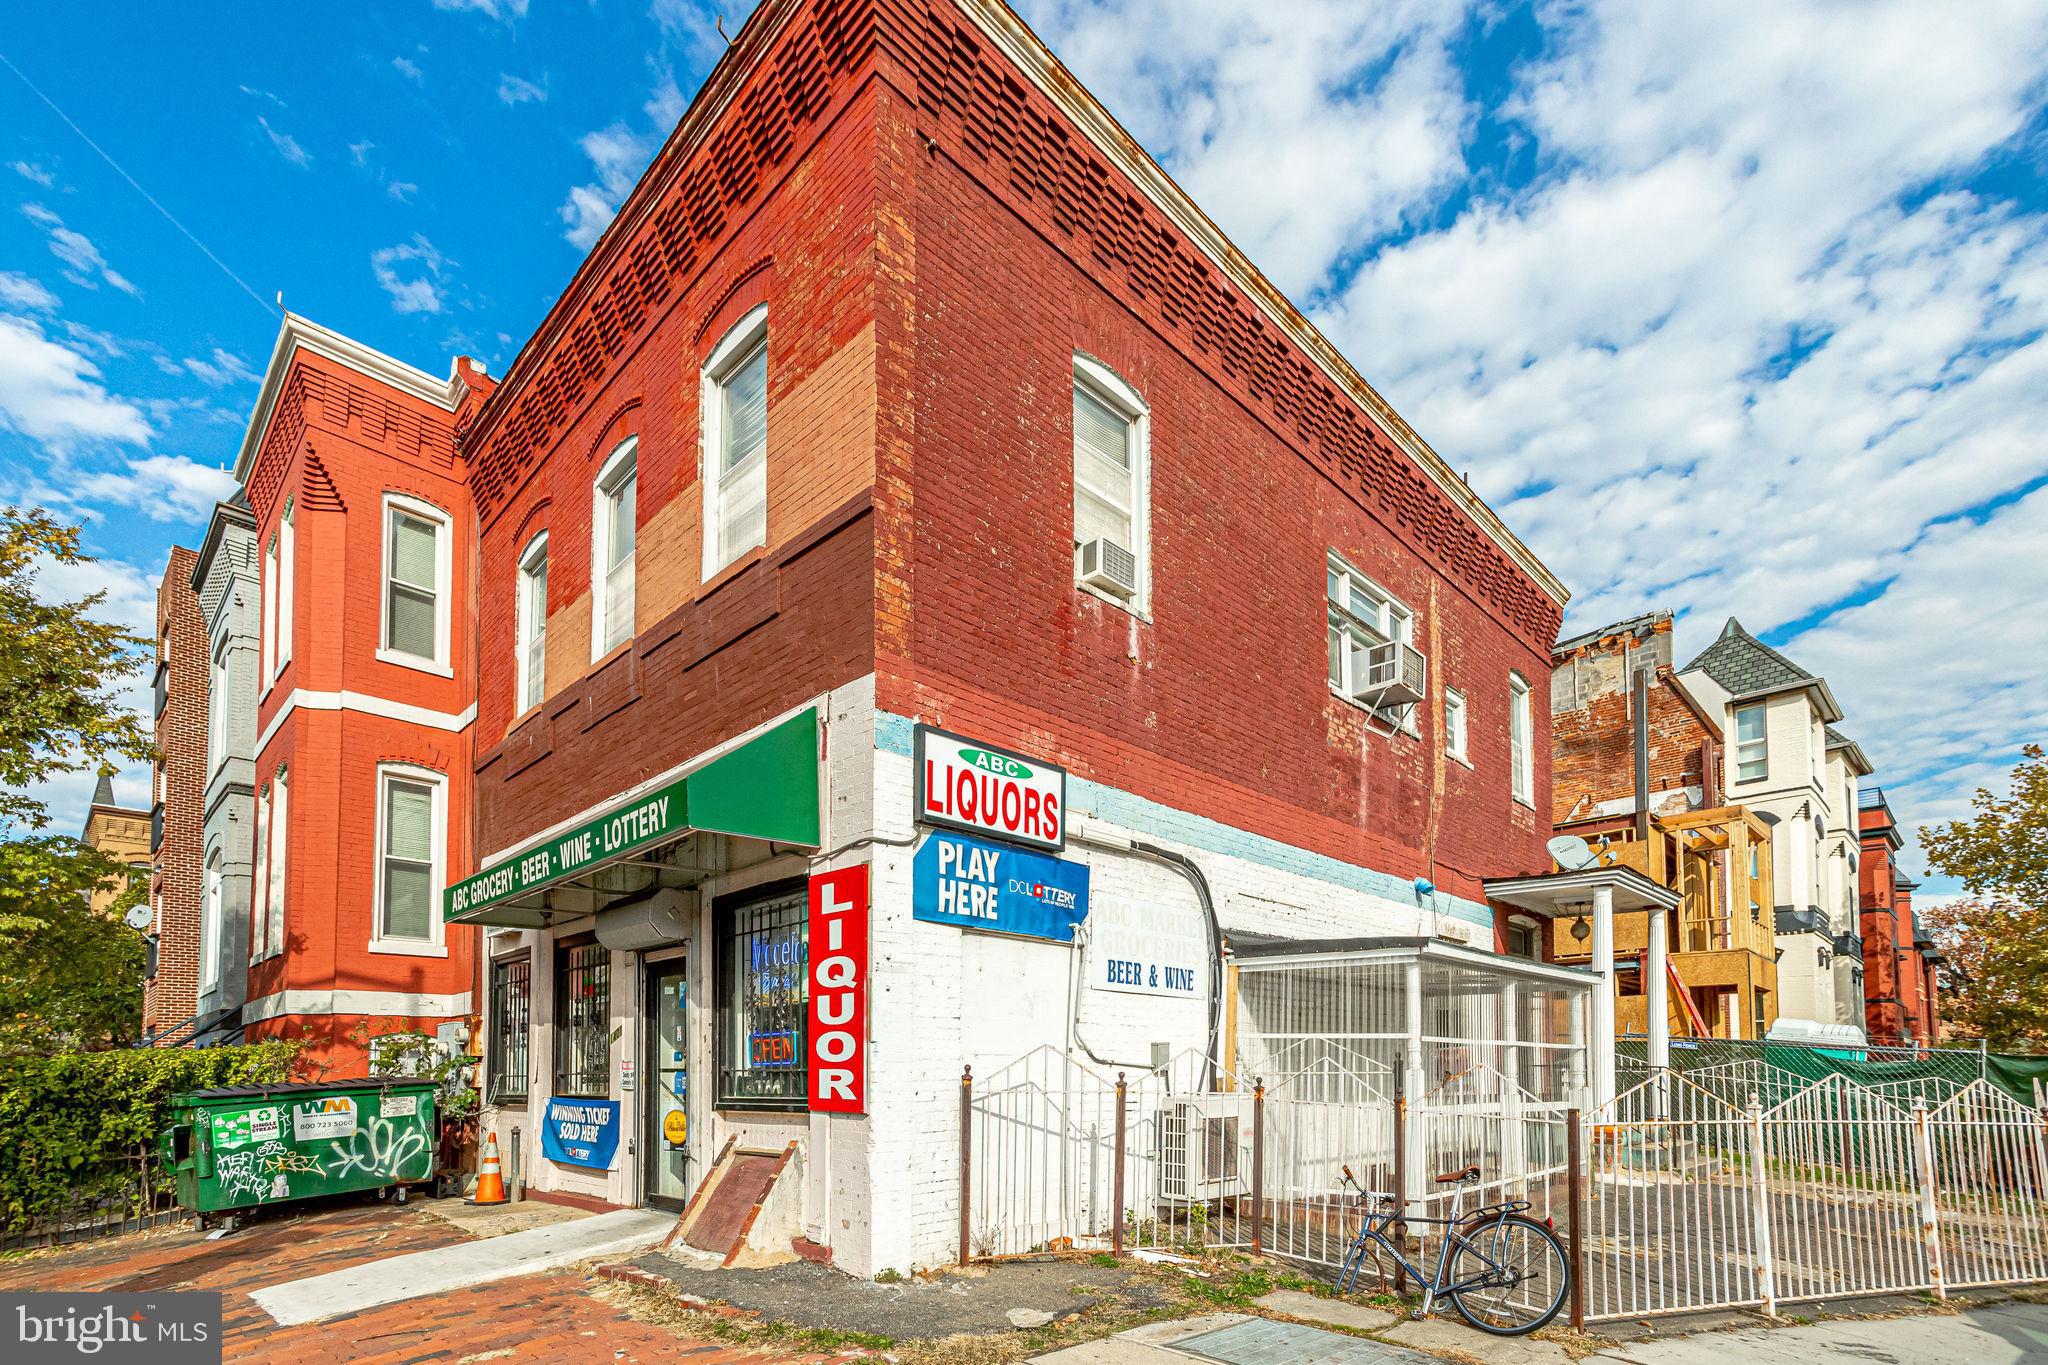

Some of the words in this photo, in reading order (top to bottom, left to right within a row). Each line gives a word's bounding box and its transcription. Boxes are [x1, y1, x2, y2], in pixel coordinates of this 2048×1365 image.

[974, 752, 1019, 777] ABC
[926, 759, 1058, 841] LIQUORS
[452, 886, 469, 913] ABC
[470, 866, 514, 905] GROCERY
[521, 851, 550, 886] BEER
[559, 831, 592, 870] WINE
[603, 796, 669, 852] LOTTERY
[938, 840, 1000, 884] PLAY
[937, 877, 998, 921] HERE
[1106, 958, 1142, 986] BEER
[1148, 963, 1159, 988] &
[1164, 965, 1195, 992] WINE
[815, 882, 858, 1101] LIQUOR
[300, 1099, 351, 1114] WM
[551, 1104, 586, 1124] WINNING
[585, 1107, 611, 1126] TICKET
[251, 1125, 278, 1133] STREAM
[252, 1120, 277, 1129] SINGLE
[300, 1122, 316, 1130] 800
[317, 1121, 332, 1129] 723
[334, 1119, 354, 1127] 5060
[559, 1122, 581, 1141] SOLD
[580, 1124, 600, 1143] HERE
